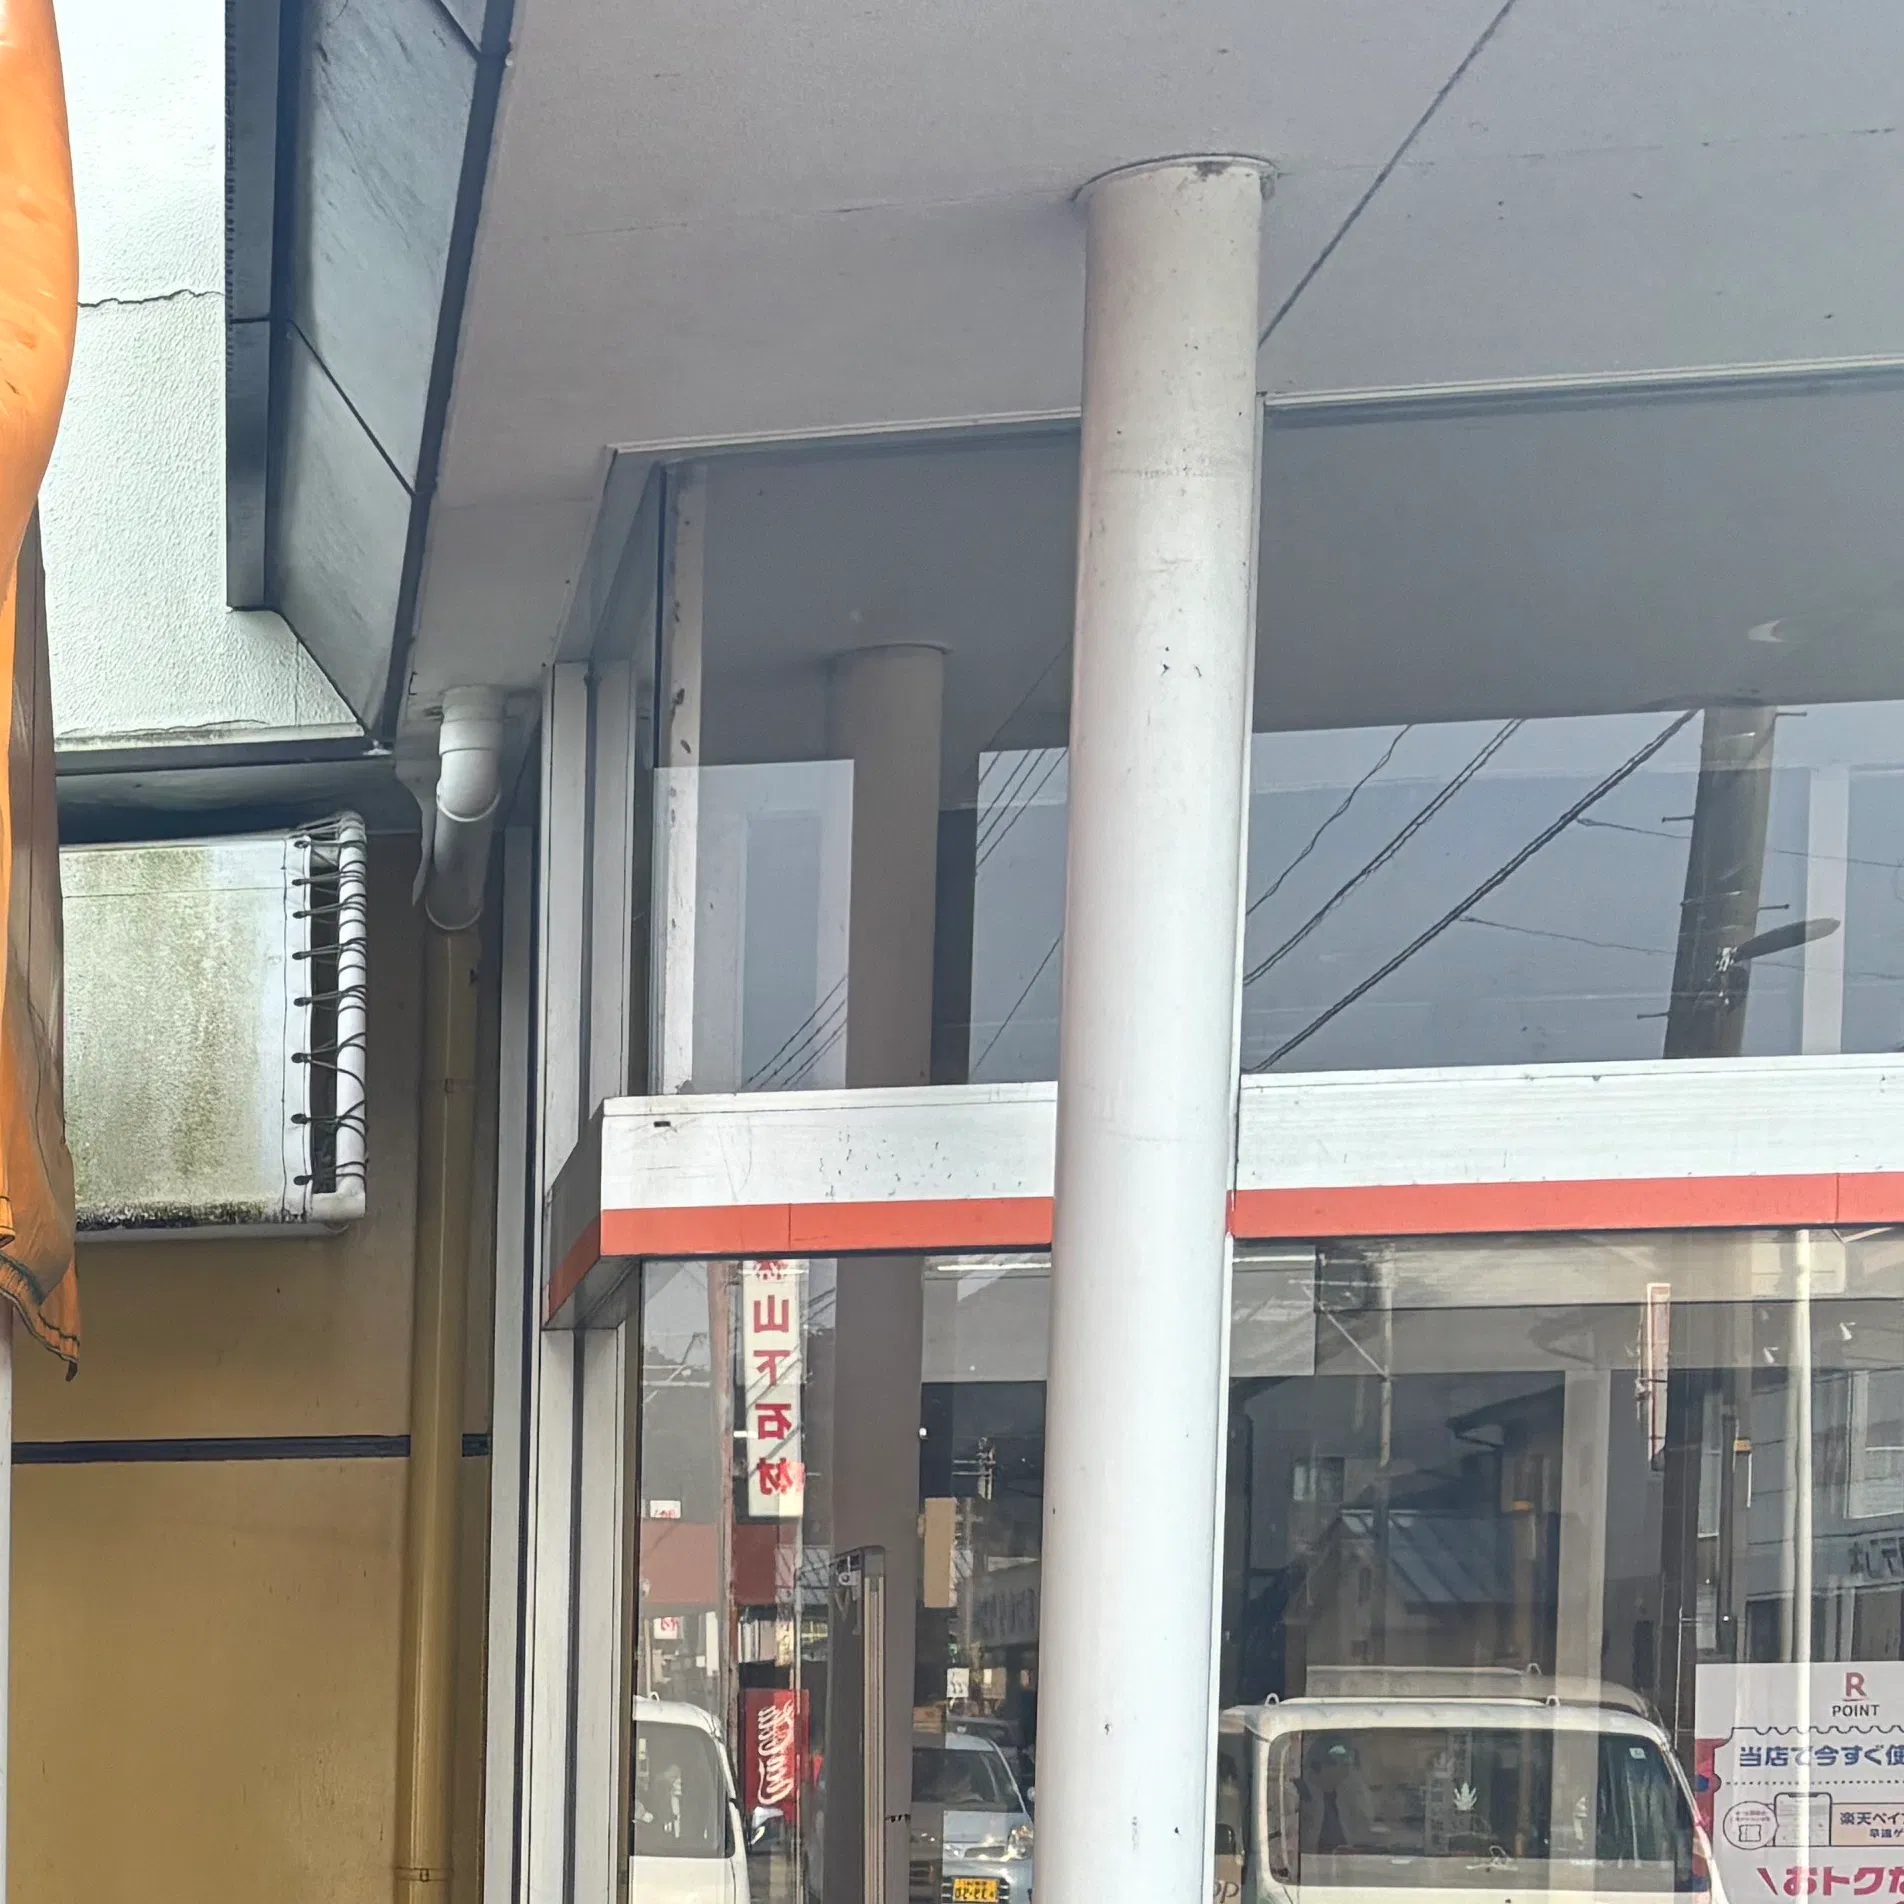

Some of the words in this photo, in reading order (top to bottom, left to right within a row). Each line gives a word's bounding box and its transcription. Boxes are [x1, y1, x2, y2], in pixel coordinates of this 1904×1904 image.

[1845, 1672, 1867, 1697] R
[1832, 1704, 1880, 1718] POINT
[1840, 1811, 1904, 1825] 楽天ペイ
